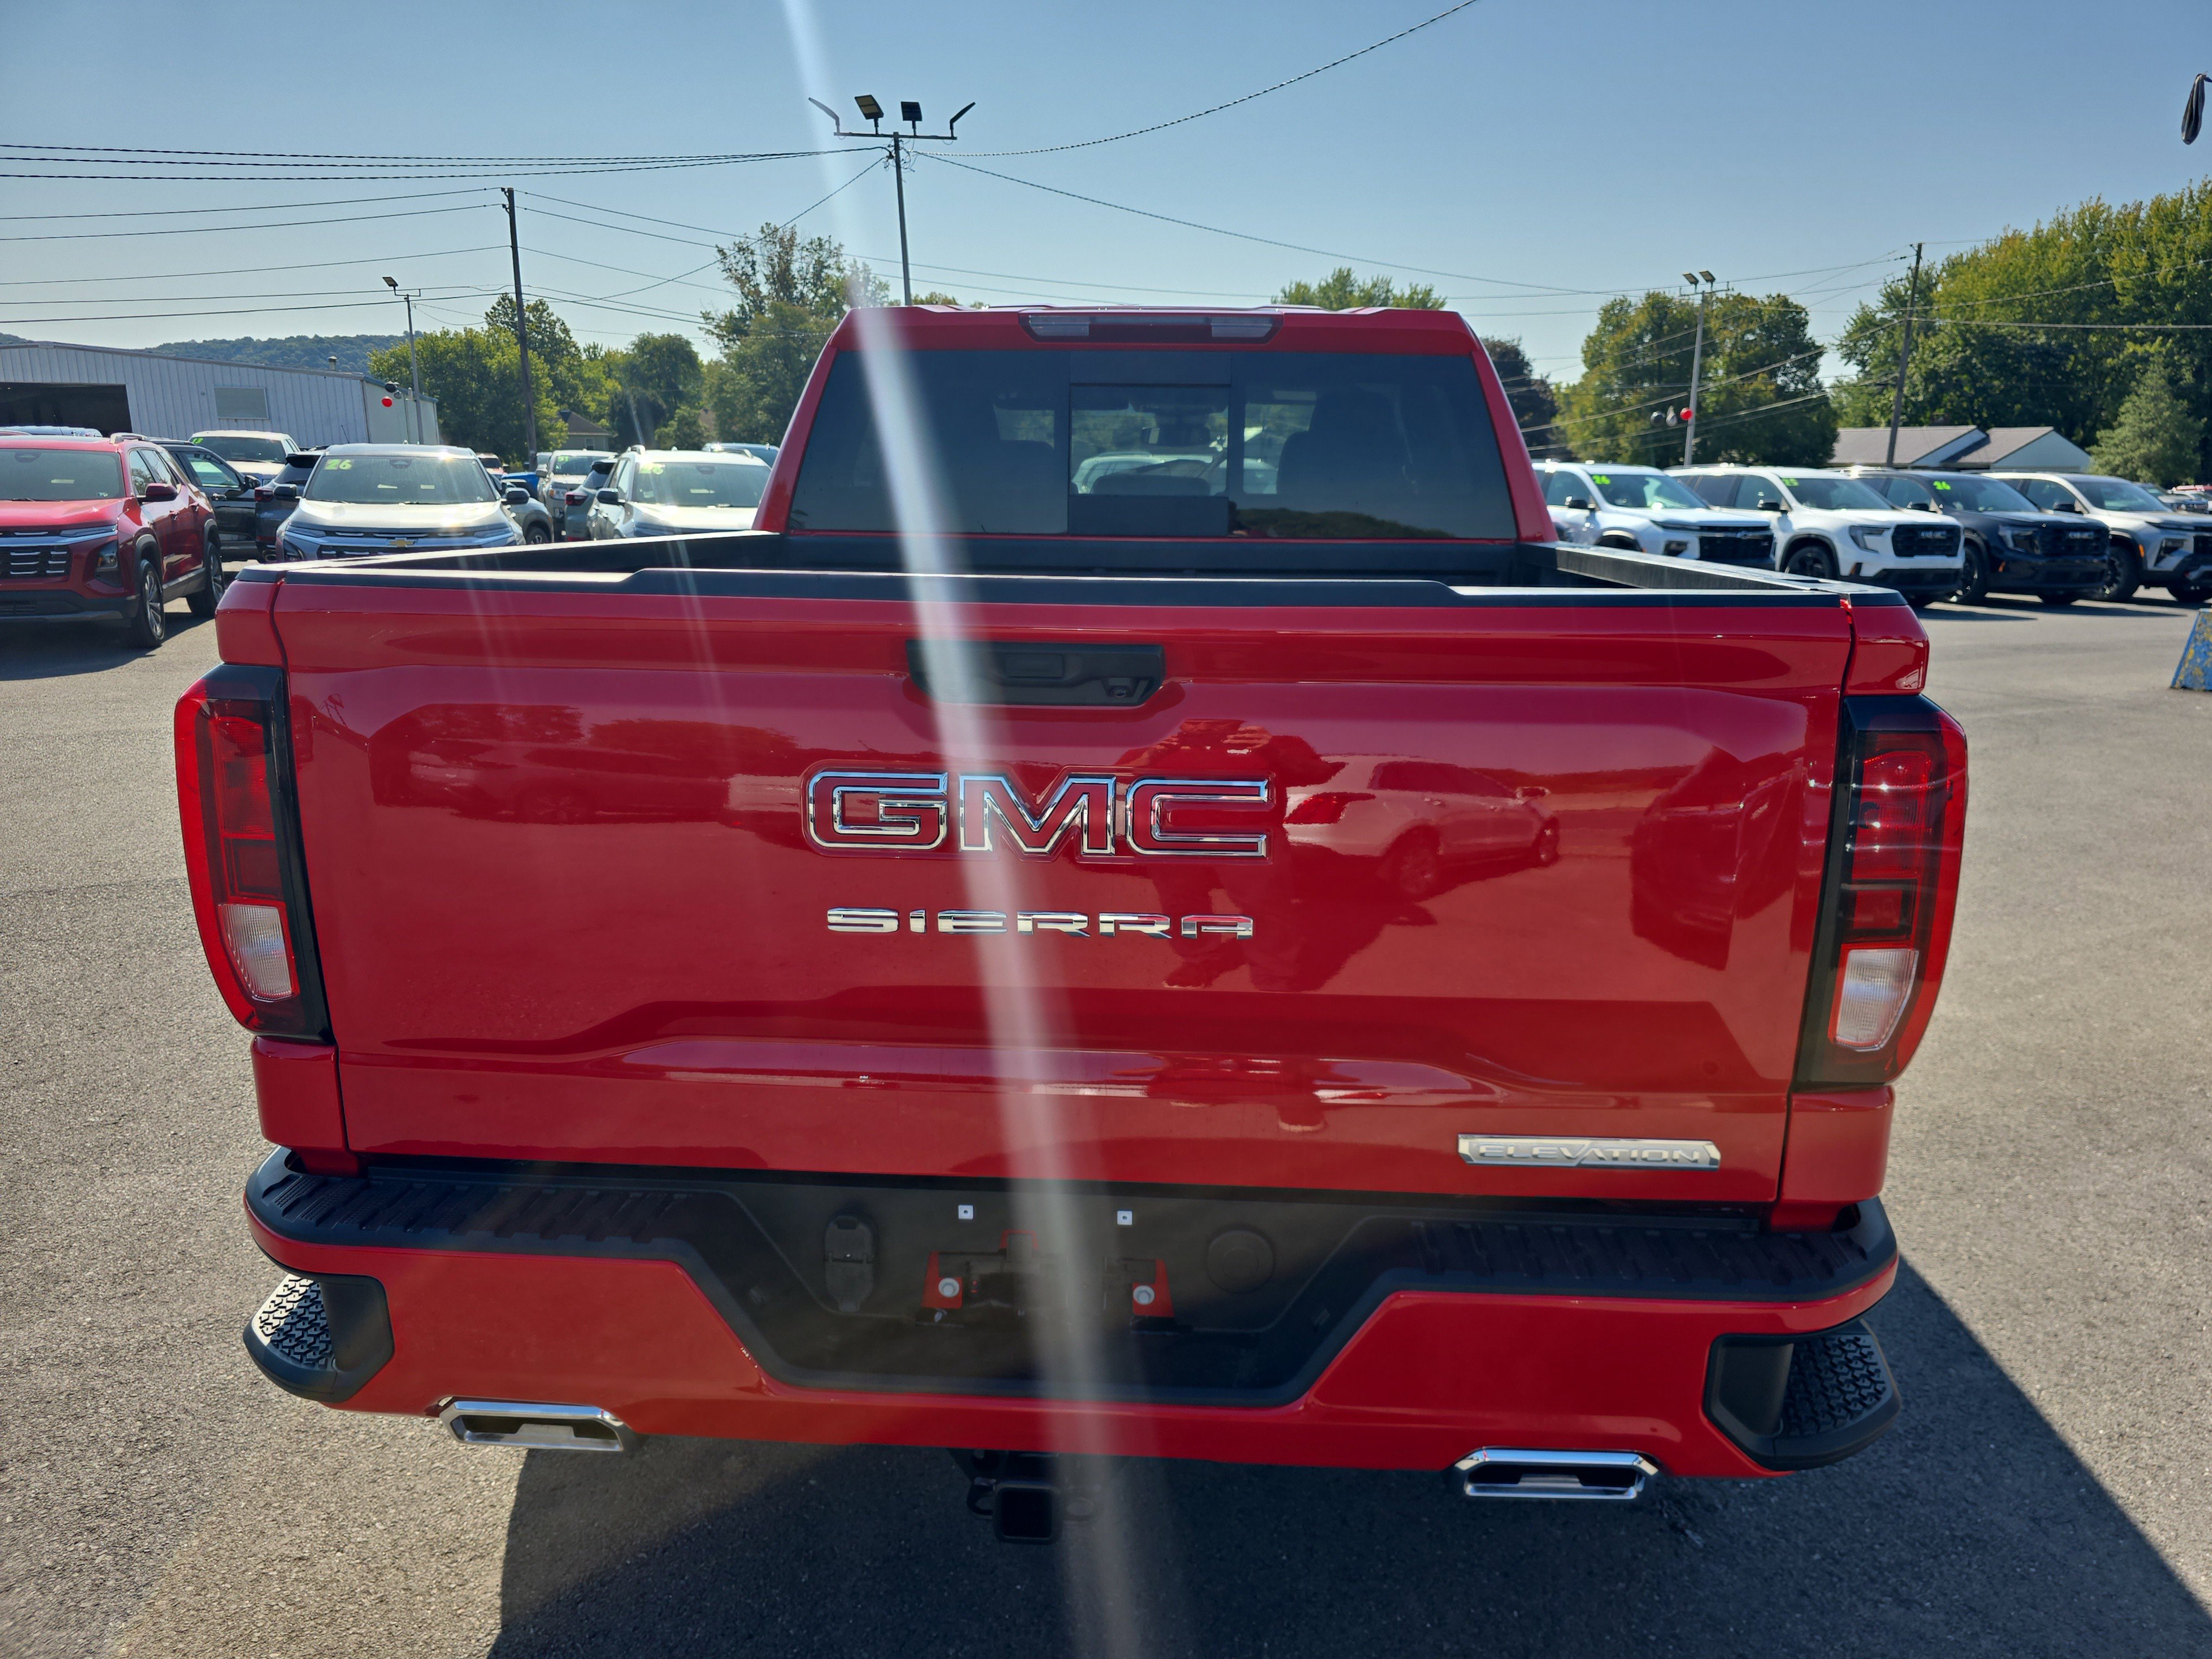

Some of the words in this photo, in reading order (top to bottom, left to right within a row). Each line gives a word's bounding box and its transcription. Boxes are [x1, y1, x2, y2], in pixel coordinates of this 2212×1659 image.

[325, 459, 352, 470] 26
[808, 770, 1269, 858] GMC
[826, 906, 1255, 941] SIERRA
[1478, 1141, 1701, 1164] ELEVATION
